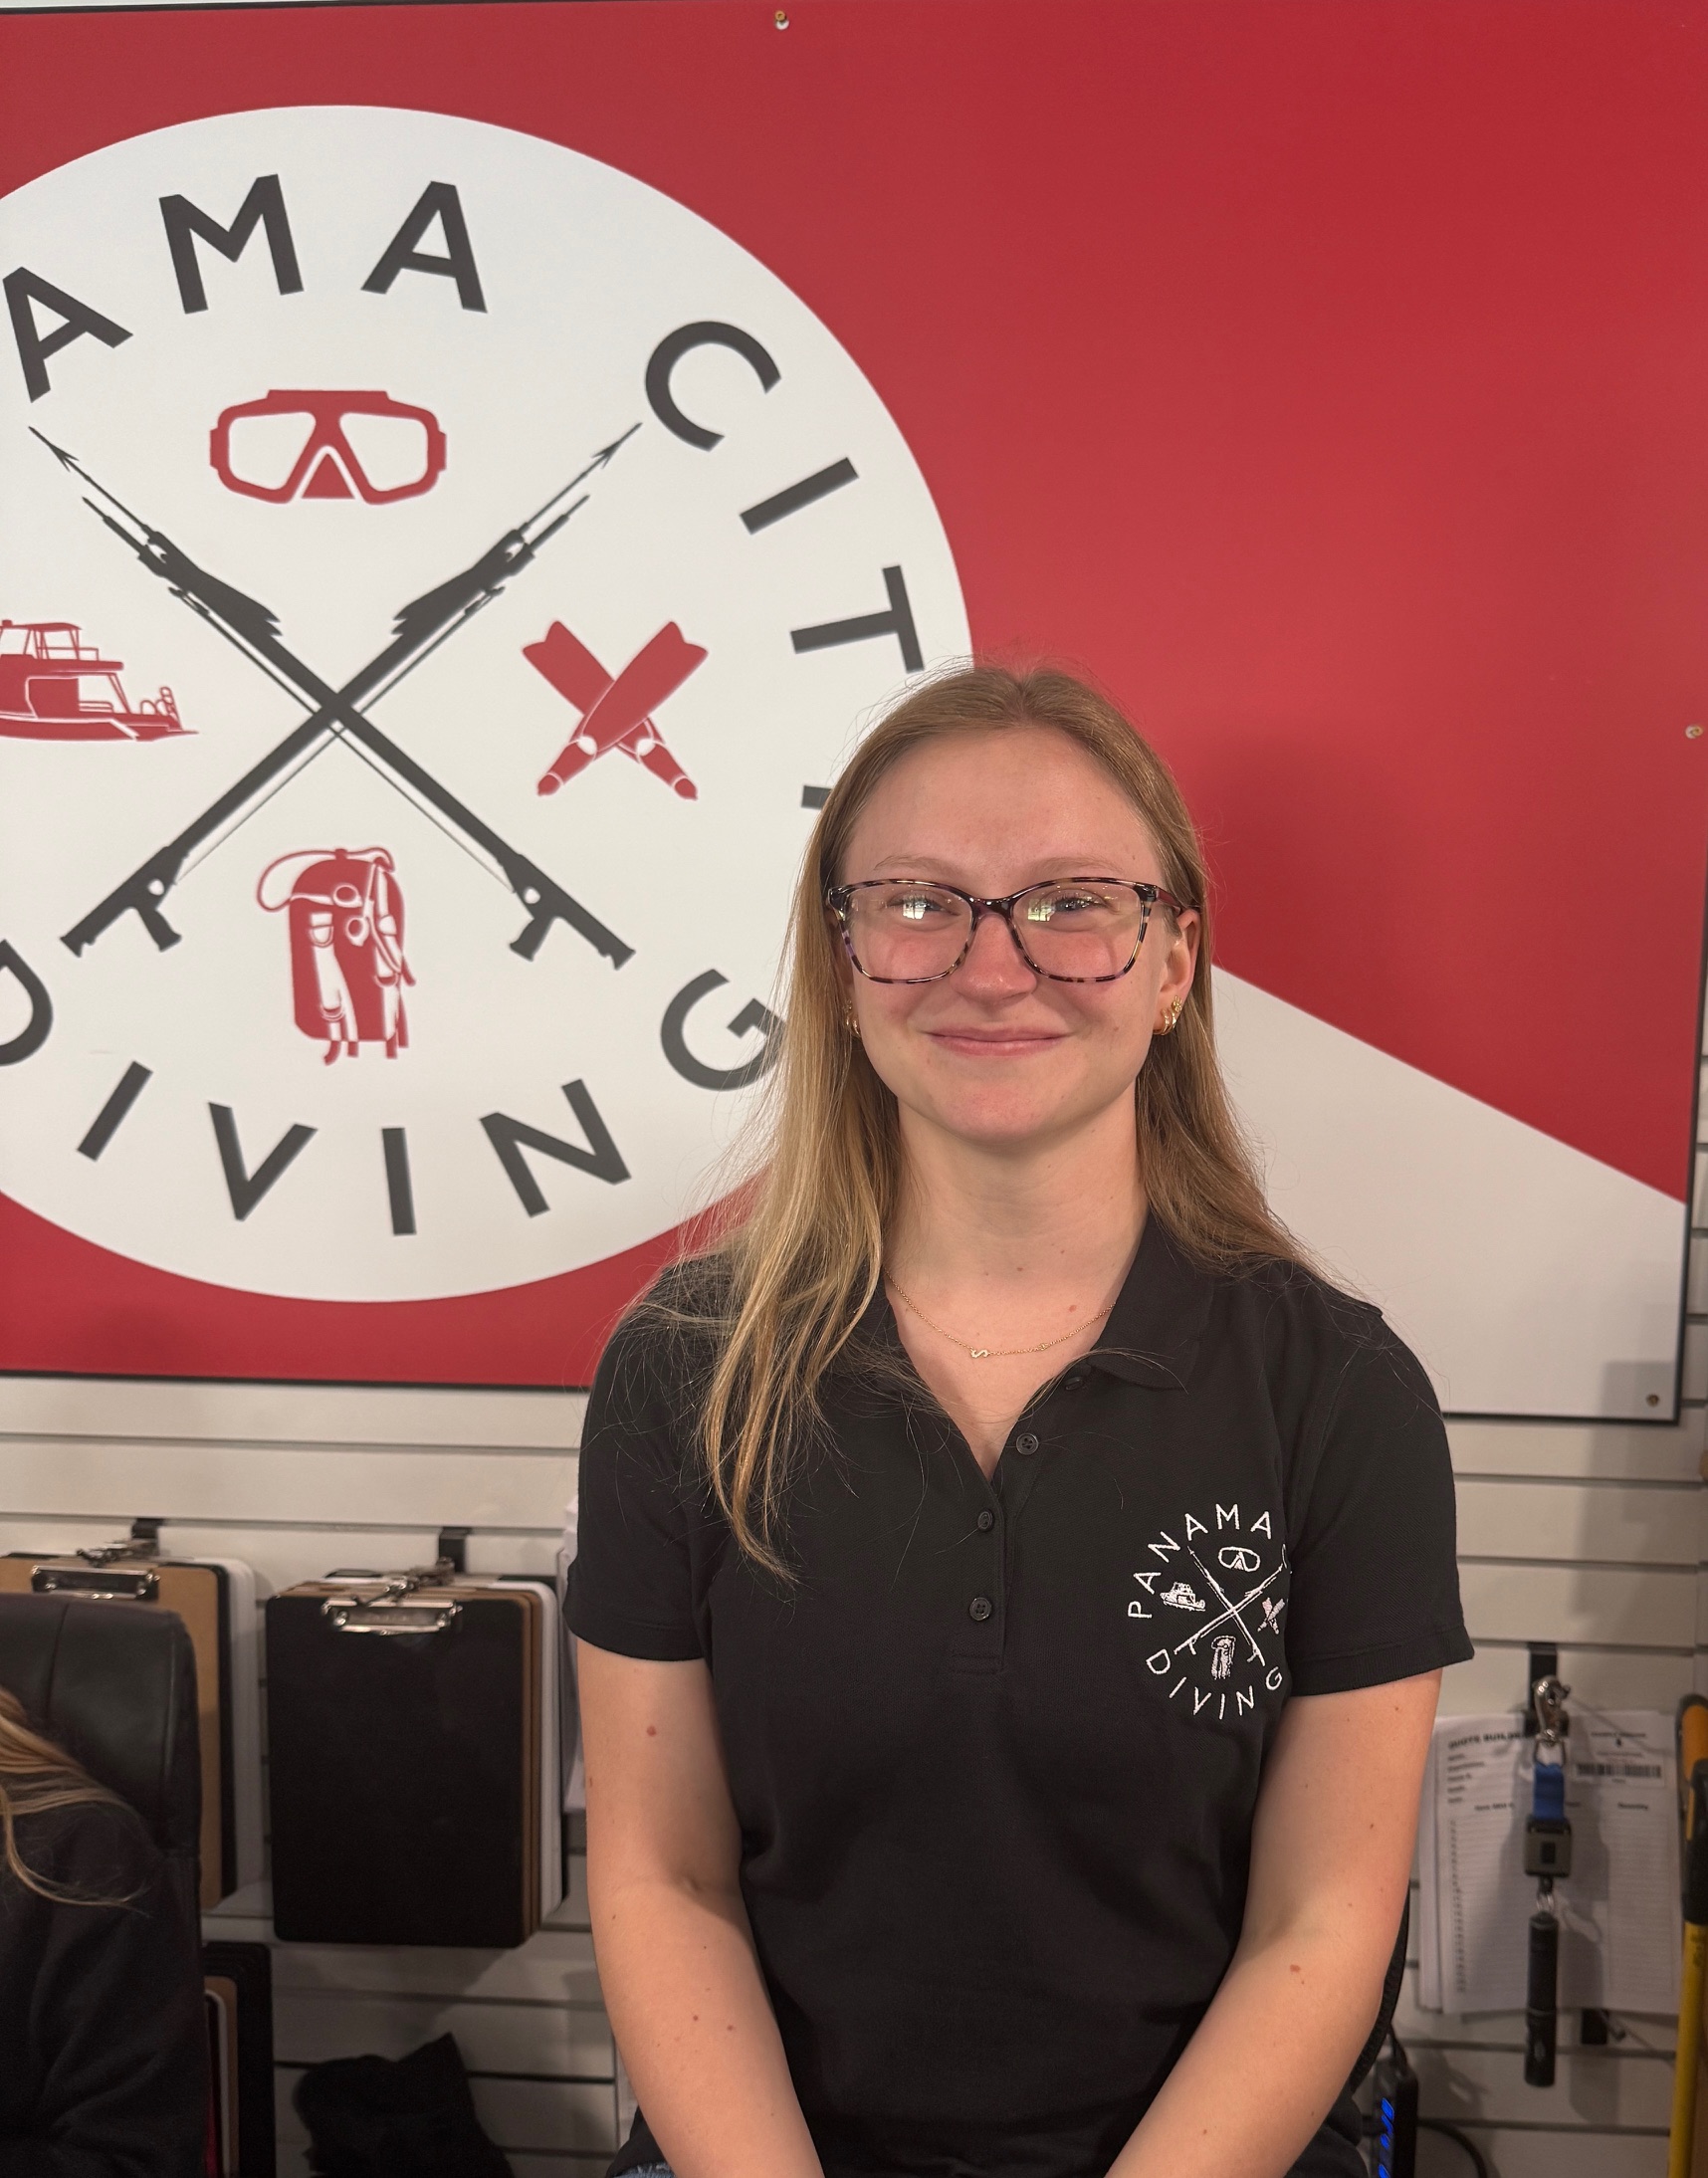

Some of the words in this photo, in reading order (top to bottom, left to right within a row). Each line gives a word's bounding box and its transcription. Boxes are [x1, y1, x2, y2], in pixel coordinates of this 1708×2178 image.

[645, 320, 926, 811] CIT
[1127, 1503, 1272, 1619] PANAMA
[1146, 1648, 1283, 1720] DIVING
